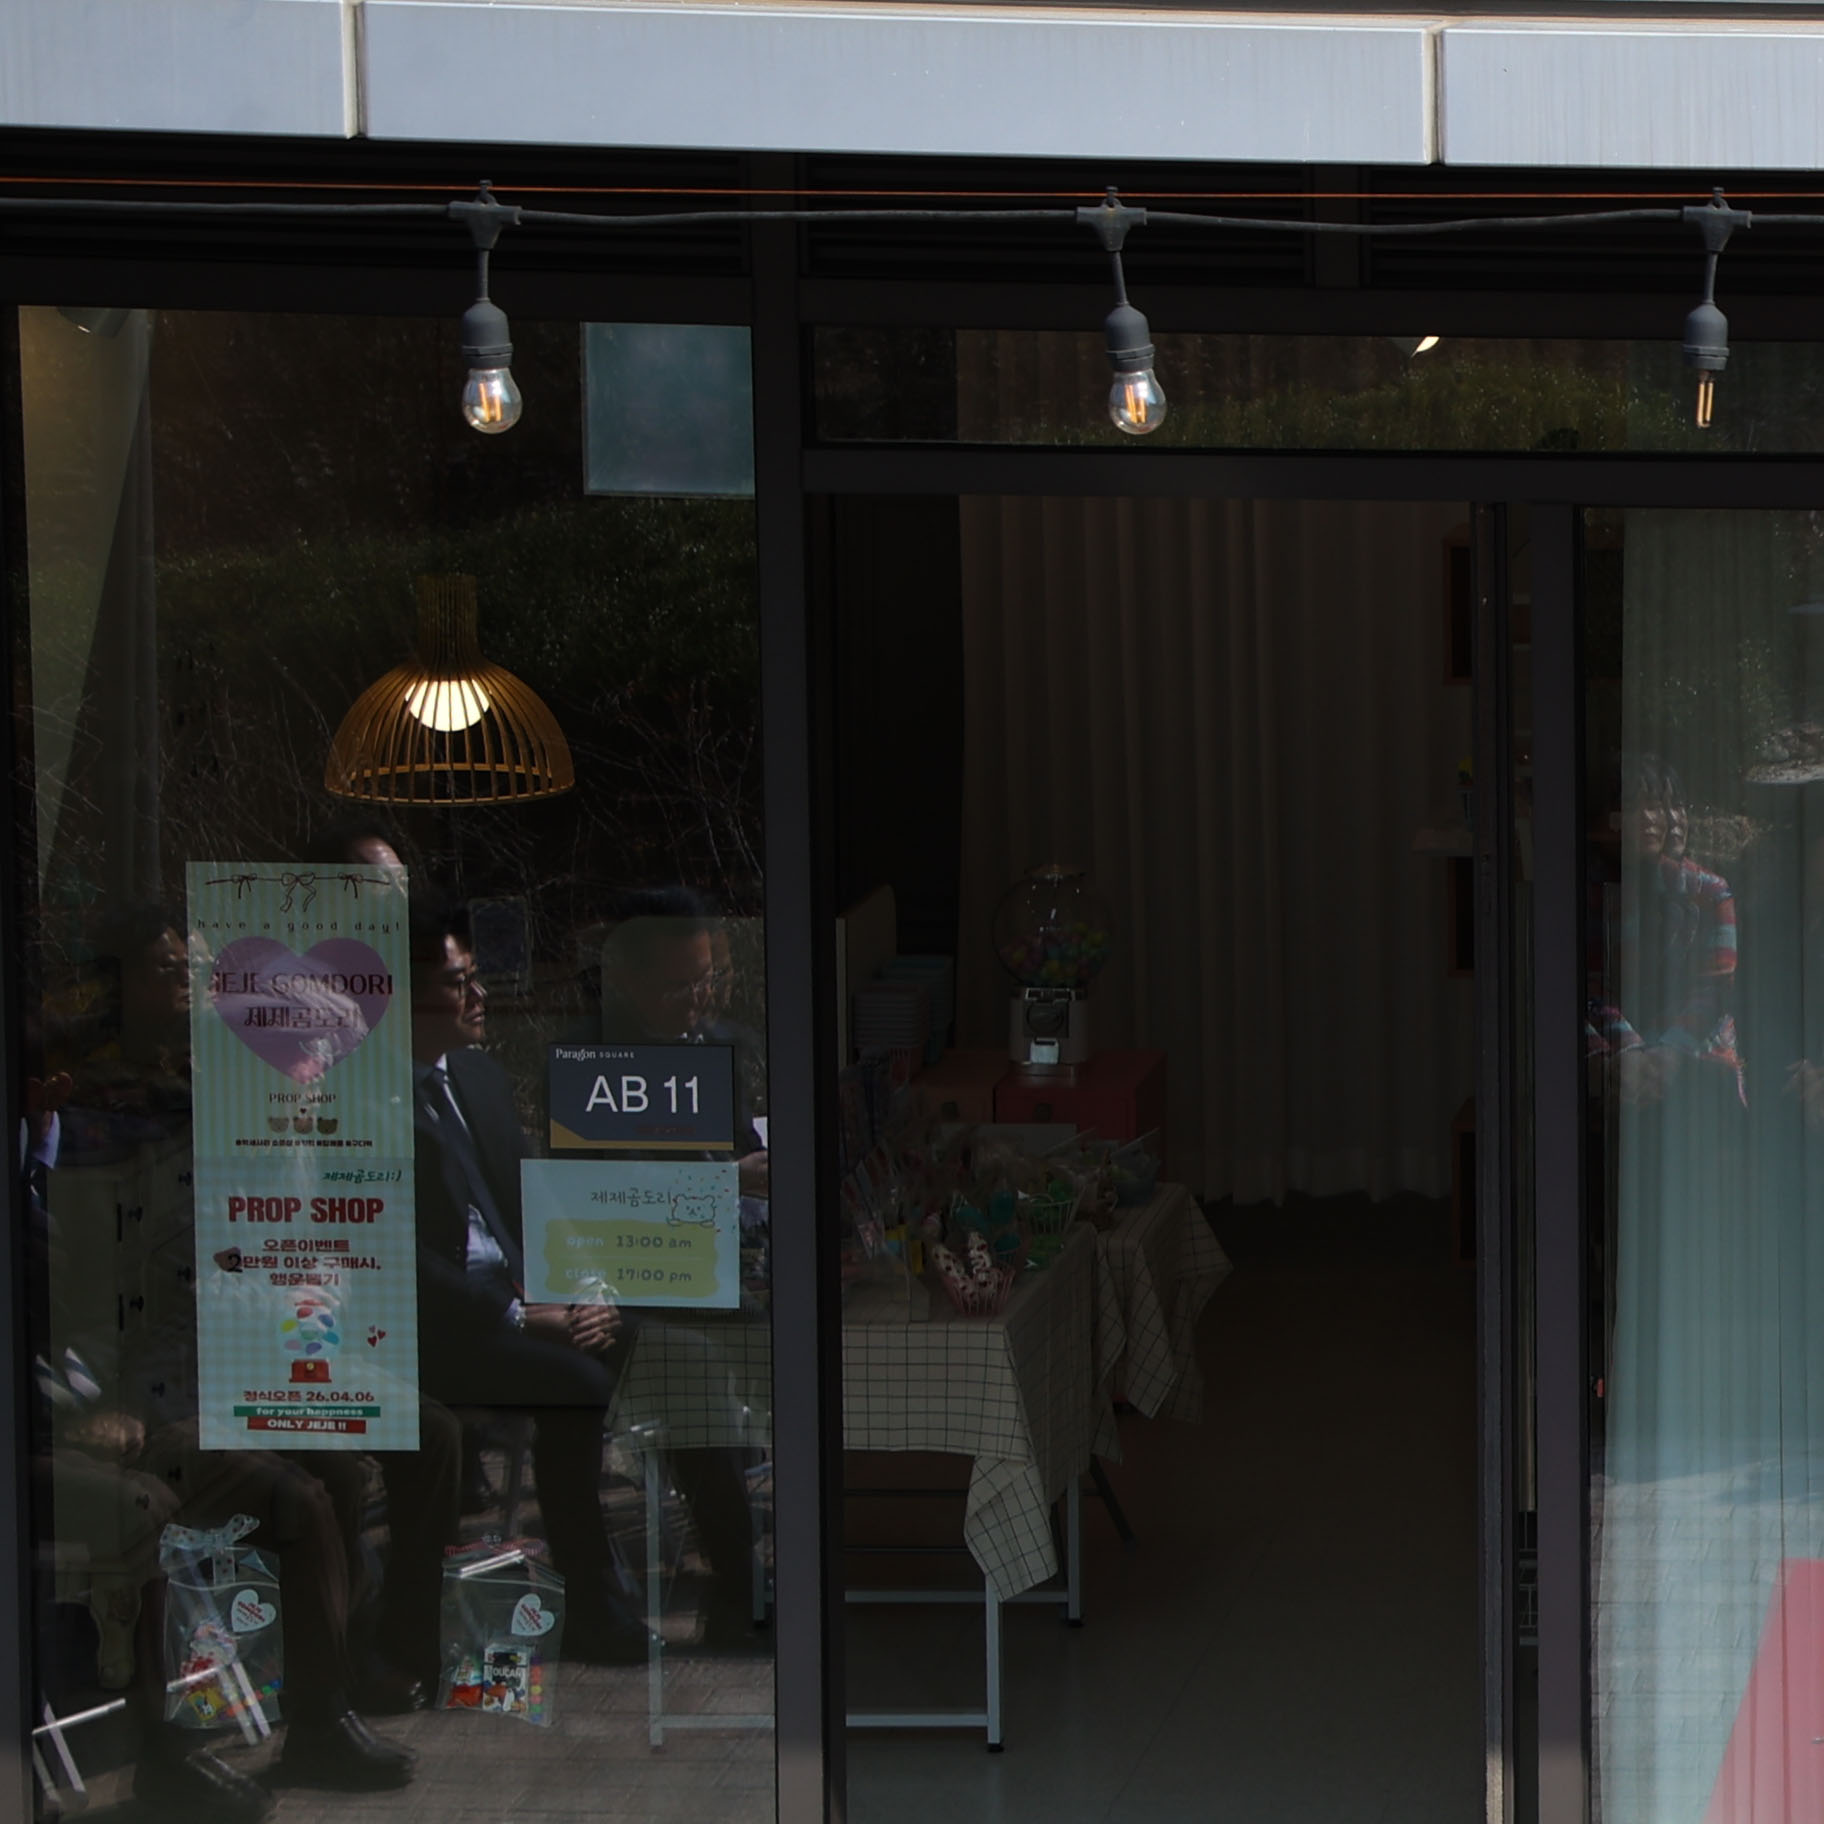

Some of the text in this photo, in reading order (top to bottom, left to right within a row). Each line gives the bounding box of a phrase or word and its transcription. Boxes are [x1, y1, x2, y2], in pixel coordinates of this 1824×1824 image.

[198, 919, 246, 929] have
[287, 919, 337, 931] good
[355, 919, 399, 933] day!
[272, 973, 392, 994] GOMDORI
[555, 1048, 596, 1061] Paragon
[269, 1093, 336, 1103] PROP SHOP
[585, 1075, 699, 1114] AB 11
[591, 1187, 671, 1207] 제제곰도리
[228, 1196, 384, 1223] PROP SHOP
[262, 1239, 350, 1252] 오픈이벤트
[669, 1238, 692, 1248] am
[284, 1256, 318, 1270] 이상
[669, 1271, 692, 1283] pm
[243, 1390, 374, 1402] 정식오픈 26.04.06
[256, 1407, 274, 1415] for
[278, 1408, 304, 1416] your
[267, 1418, 304, 1429] ONLY
[307, 1420, 336, 1430] JEJE
